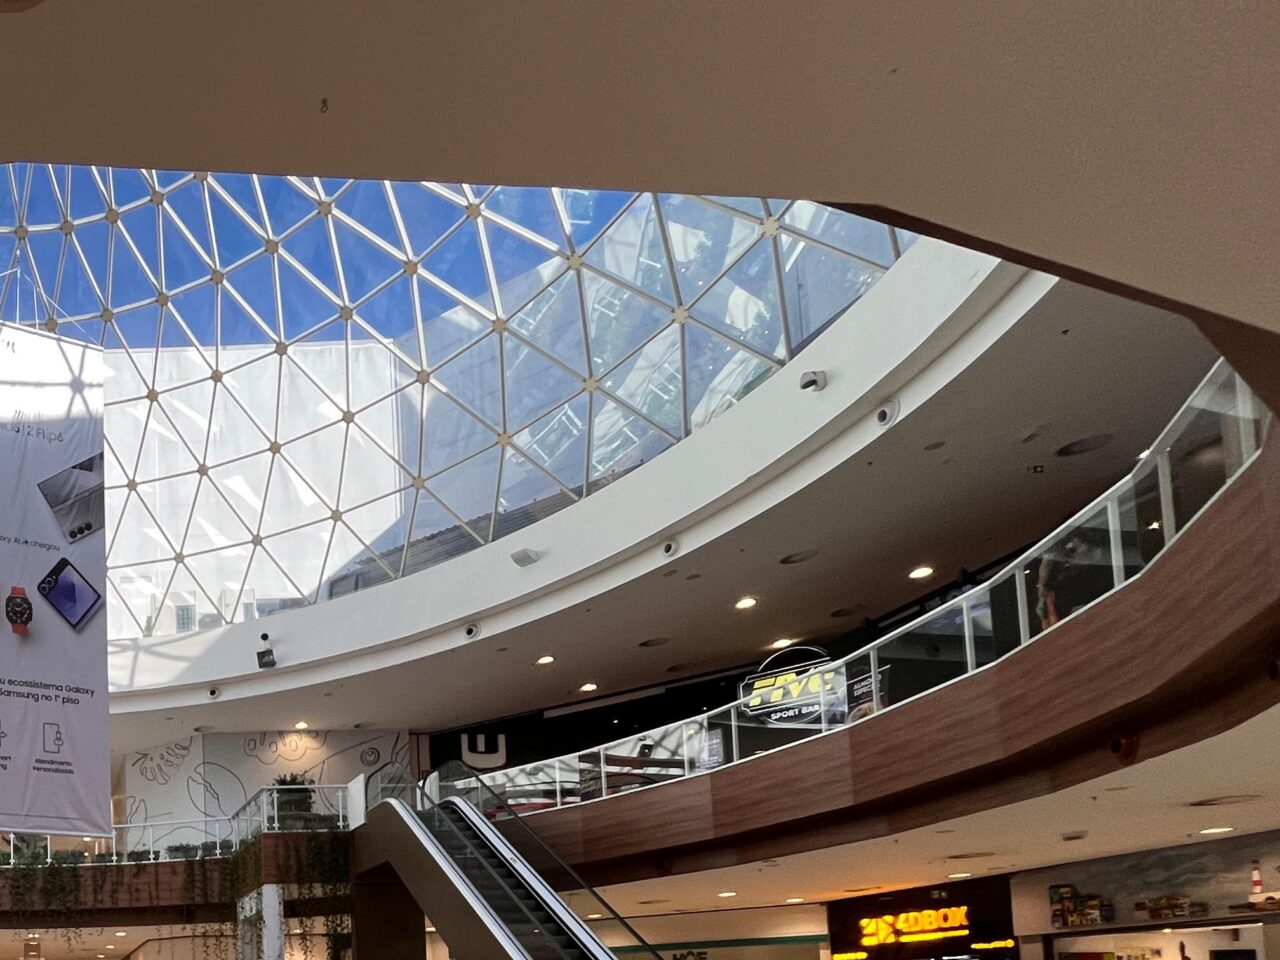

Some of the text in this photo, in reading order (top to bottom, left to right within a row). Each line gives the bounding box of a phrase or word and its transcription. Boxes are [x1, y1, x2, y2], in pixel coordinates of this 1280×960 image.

[36, 427, 64, 444] Flip6
[30, 540, 60, 551] chegou
[7, 678, 63, 692] ecossistema
[65, 684, 95, 697] Galaxy
[62, 695, 80, 706] piso
[770, 703, 819, 720] SPORT BAR
[895, 906, 969, 932] 4DBOX
